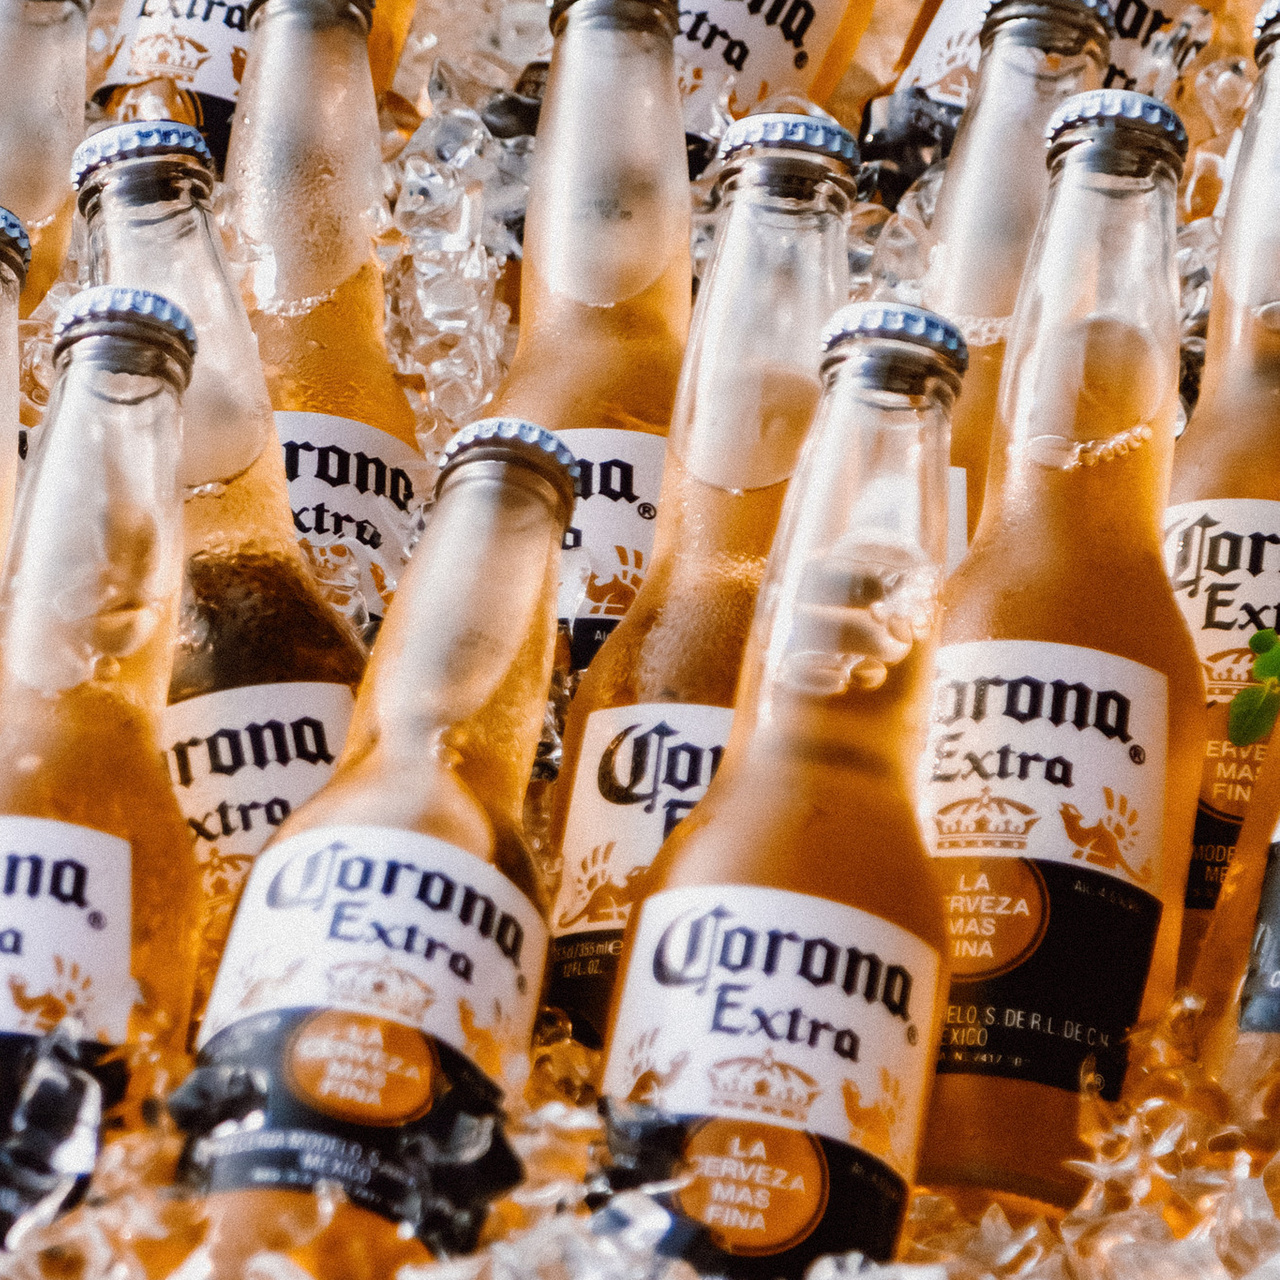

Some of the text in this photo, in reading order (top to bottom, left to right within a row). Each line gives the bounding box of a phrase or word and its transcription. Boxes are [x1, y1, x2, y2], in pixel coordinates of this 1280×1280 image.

[677, 9, 750, 71] tra
[272, 439, 415, 515] rona
[291, 502, 384, 550] xtra
[170, 715, 336, 790] rona
[1213, 783, 1252, 802] FIN
[187, 796, 292, 842] xtra
[265, 839, 524, 970] Corona
[945, 894, 1031, 917] RVEZA
[958, 872, 991, 892] LA
[328, 899, 473, 986] Extra
[652, 903, 913, 1022] Corona
[953, 939, 994, 959] INA
[710, 983, 862, 1064] Extra
[729, 1135, 768, 1161] LA
[703, 1203, 767, 1232] FINA
[710, 1180, 771, 1210] MAS
